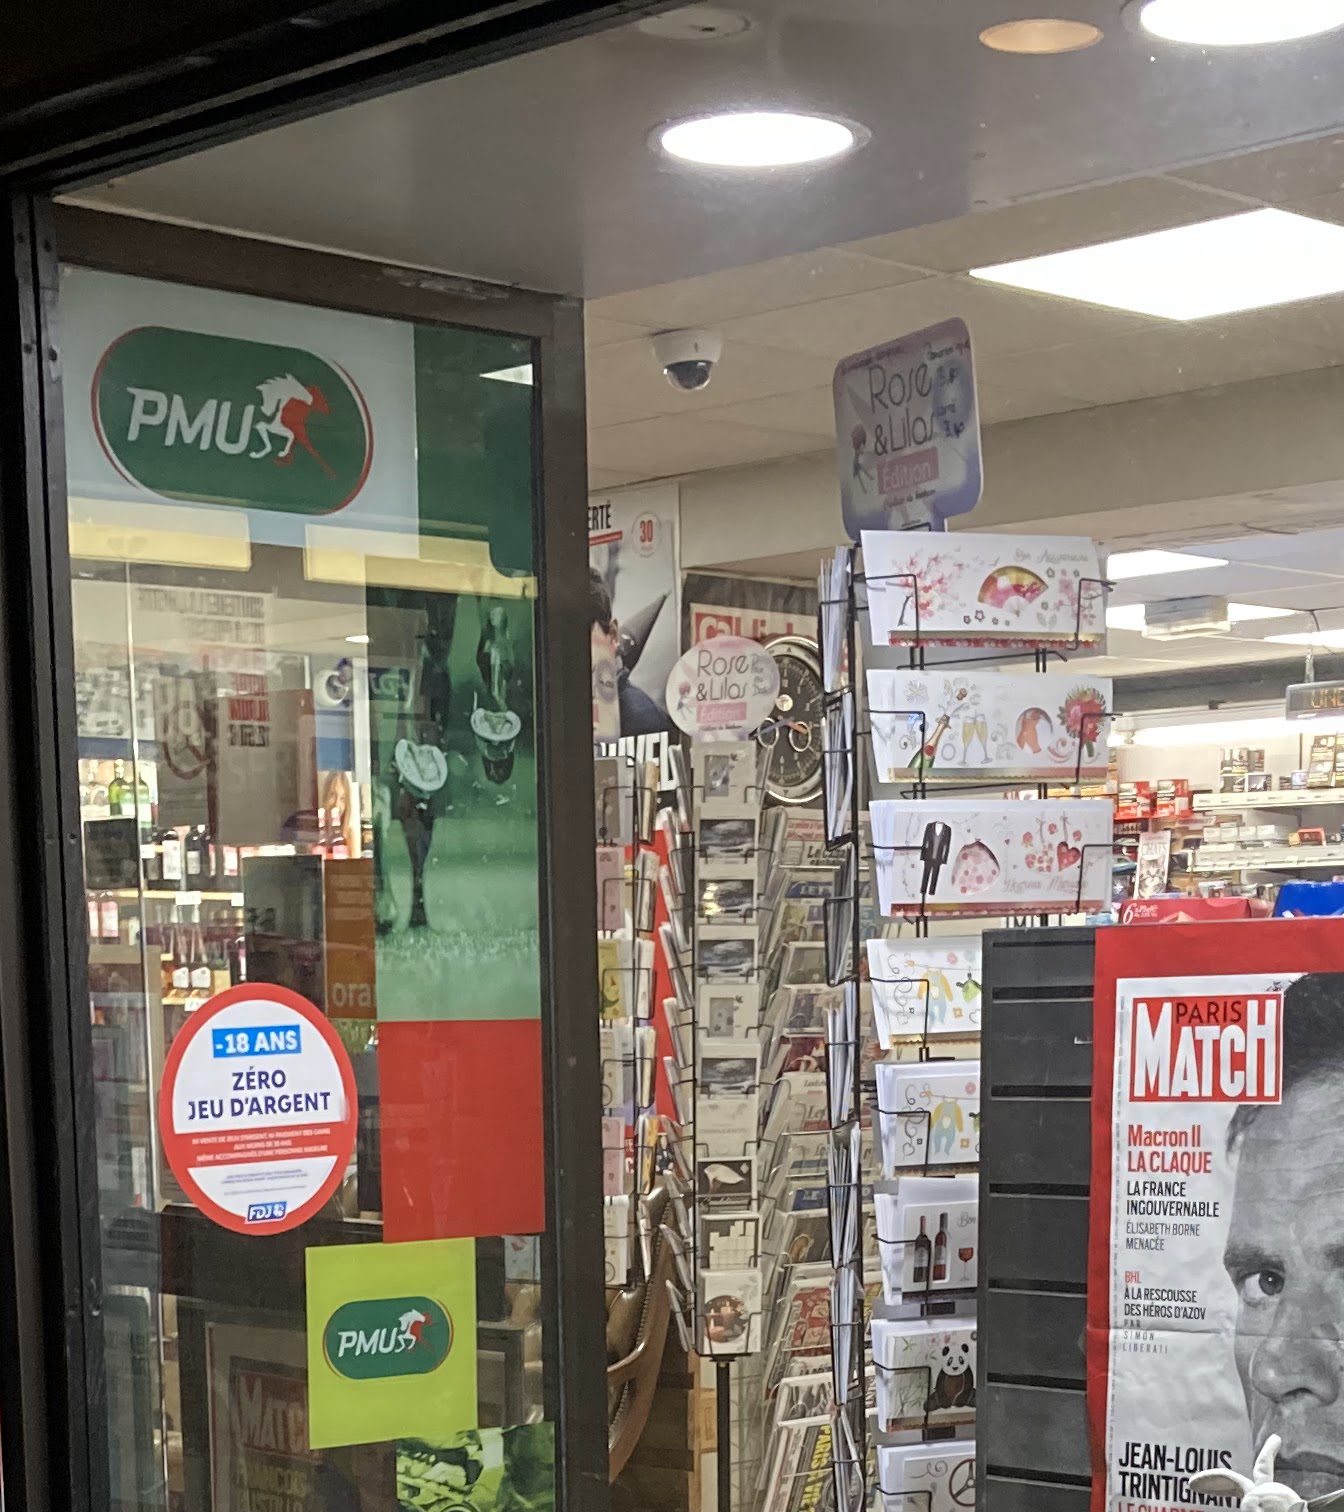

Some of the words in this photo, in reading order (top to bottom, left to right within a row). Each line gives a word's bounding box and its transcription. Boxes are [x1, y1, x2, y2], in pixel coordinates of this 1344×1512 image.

[869, 363, 932, 413] Rose
[126, 386, 254, 454] PMU
[640, 520, 653, 543] 30
[697, 650, 749, 676] Rose
[1176, 1001, 1242, 1024] PARIS
[215, 1034, 250, 1053] -18
[254, 1030, 298, 1051] ANS
[1133, 999, 1277, 1097] MATCH
[232, 1066, 286, 1091] ZÉRO
[188, 1097, 223, 1119] JEU
[230, 1091, 330, 1117] D'ARGENT
[1128, 1124, 1186, 1148] Macron
[1127, 1151, 1148, 1173] LA
[1150, 1151, 1213, 1176] CLAQUE
[1127, 1181, 1140, 1196] LA
[1143, 1182, 1186, 1197] FRANCE
[249, 1204, 273, 1221] FDJ
[1127, 1200, 1219, 1218] INGOUVERNABLE
[1126, 1221, 1171, 1236] ÉLISABETH
[1172, 1222, 1200, 1237] BORNE
[1126, 1235, 1165, 1251] MENACÉE
[1124, 1271, 1141, 1284] BHL
[1131, 1289, 1143, 1301] LA
[1144, 1289, 1197, 1303] RESCOUSSE
[1124, 1303, 1141, 1316] DES
[1143, 1302, 1173, 1318] HÉROS
[1174, 1305, 1206, 1320] D'AZOV
[1124, 1319, 1141, 1328] PAR
[337, 1328, 398, 1357] PMU
[1123, 1332, 1154, 1342] SIMON
[1118, 1442, 1232, 1472] JEAN-LOUIS
